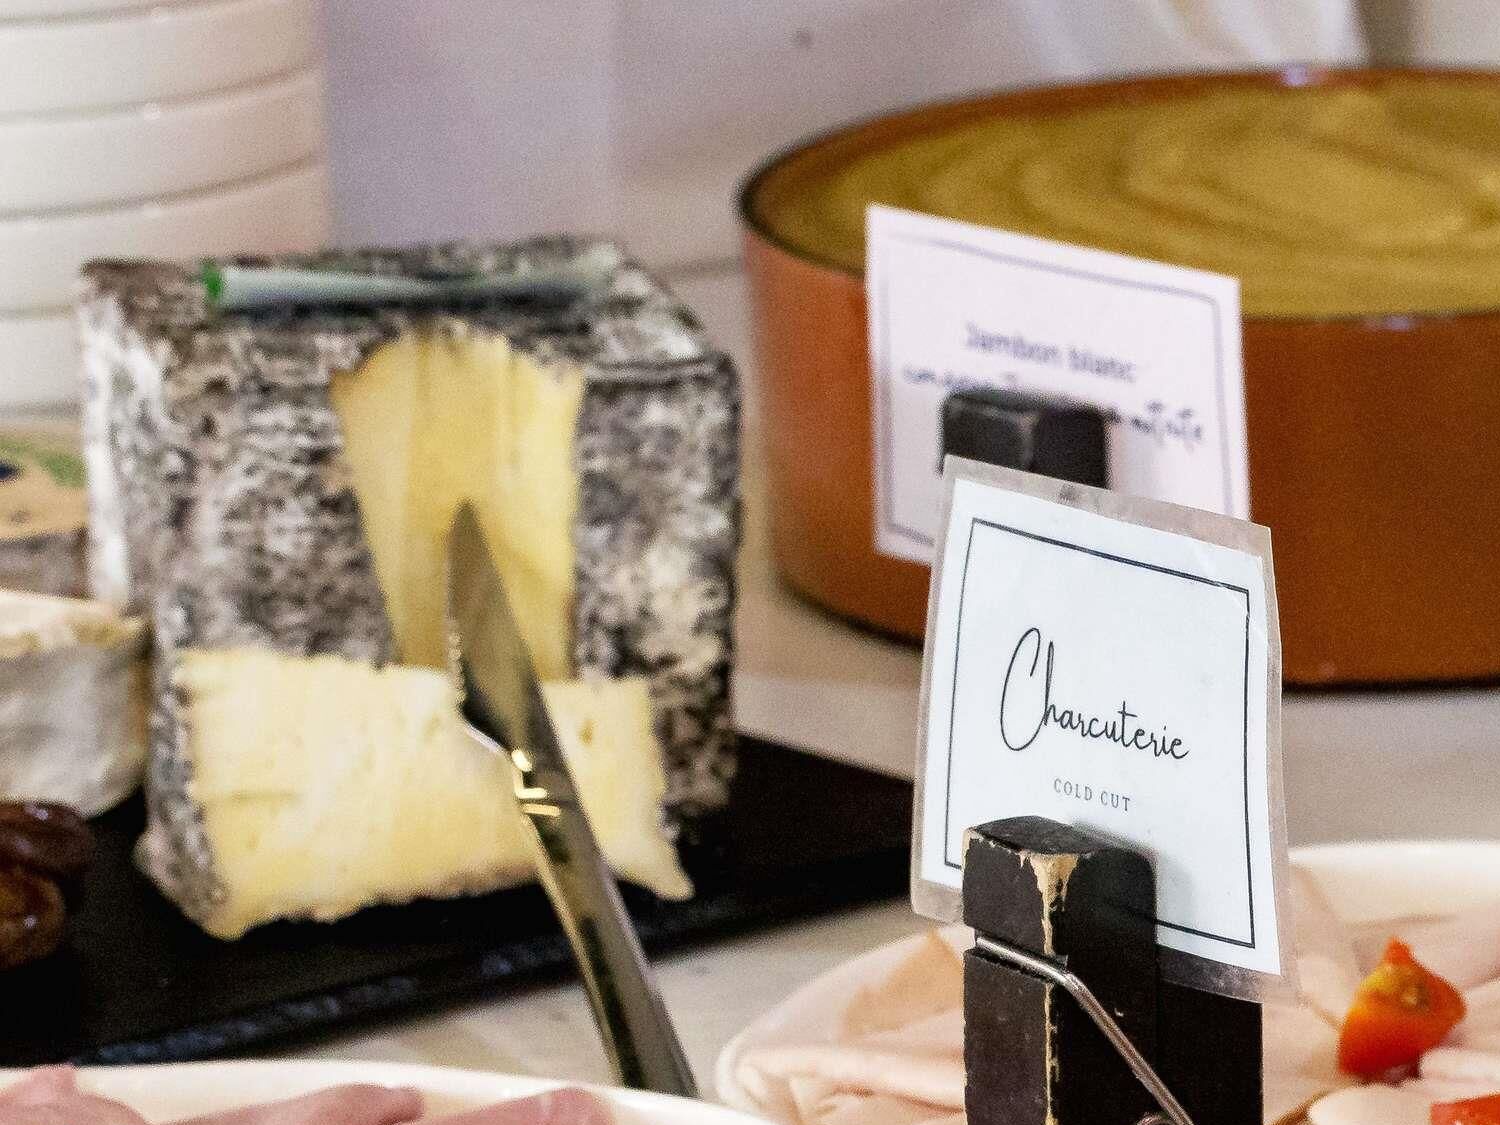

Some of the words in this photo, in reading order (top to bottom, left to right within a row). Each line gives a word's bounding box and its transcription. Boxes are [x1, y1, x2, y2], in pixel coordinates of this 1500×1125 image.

[1000, 627, 1190, 760] Charcuterie
[1053, 778, 1093, 801] COLD
[1100, 790, 1131, 812] CUT
